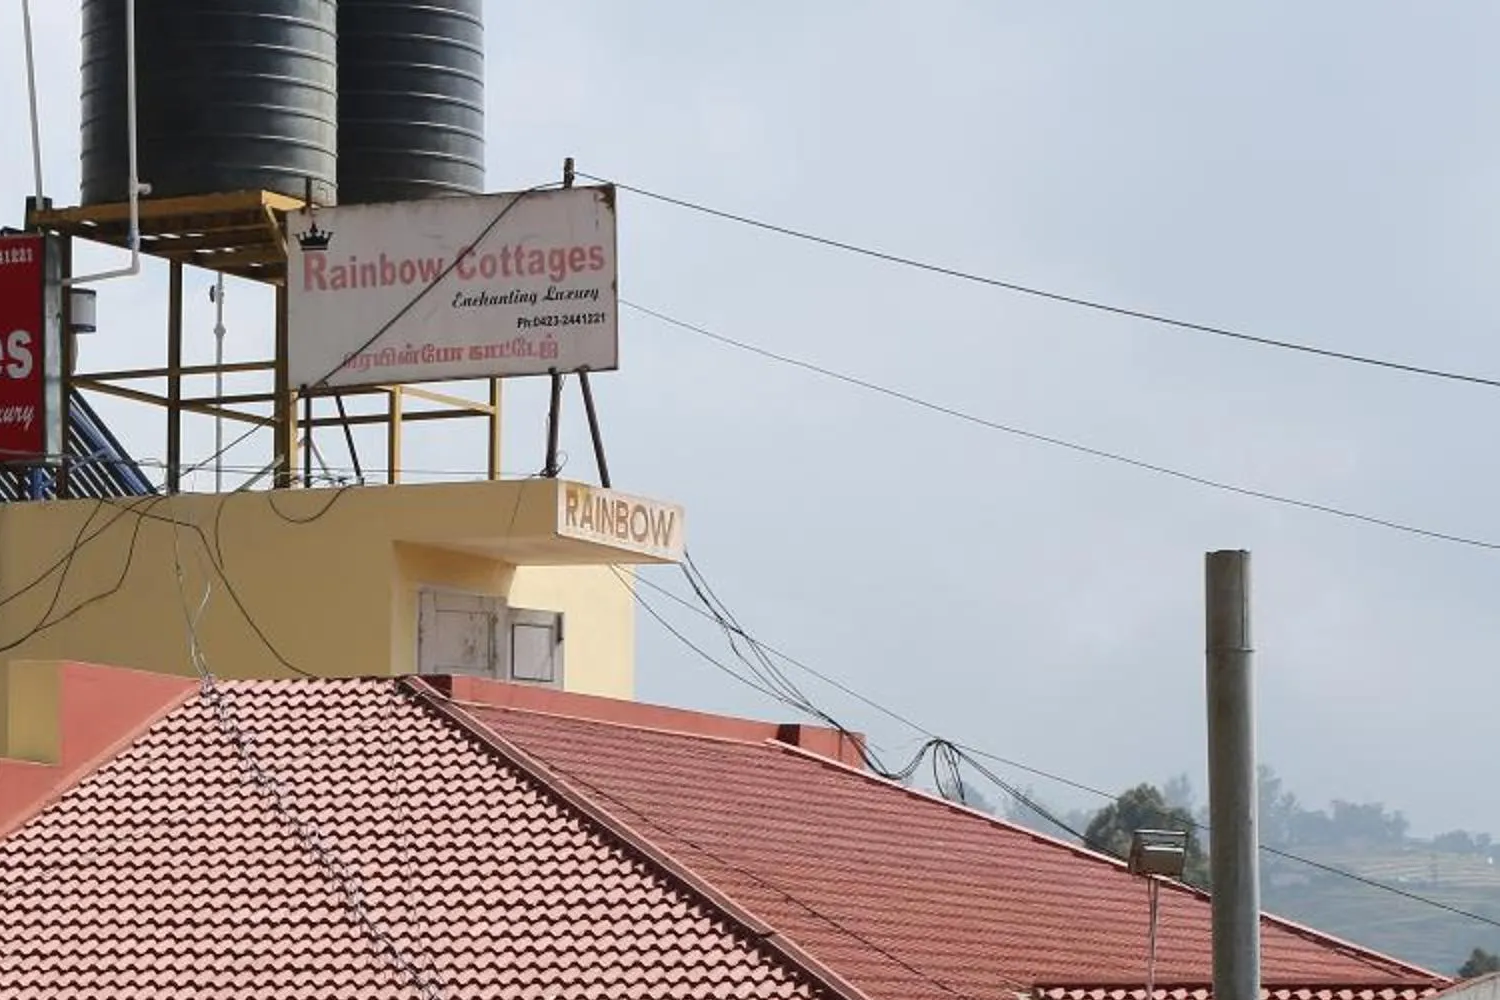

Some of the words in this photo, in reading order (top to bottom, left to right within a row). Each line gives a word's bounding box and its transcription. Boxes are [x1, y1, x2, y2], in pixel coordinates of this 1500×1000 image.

[303, 252, 444, 292] Rainbow
[456, 246, 606, 283] Cottages
[452, 288, 538, 308] Enchanting
[543, 285, 600, 302] Luxury
[566, 485, 675, 546] RAINBOW
